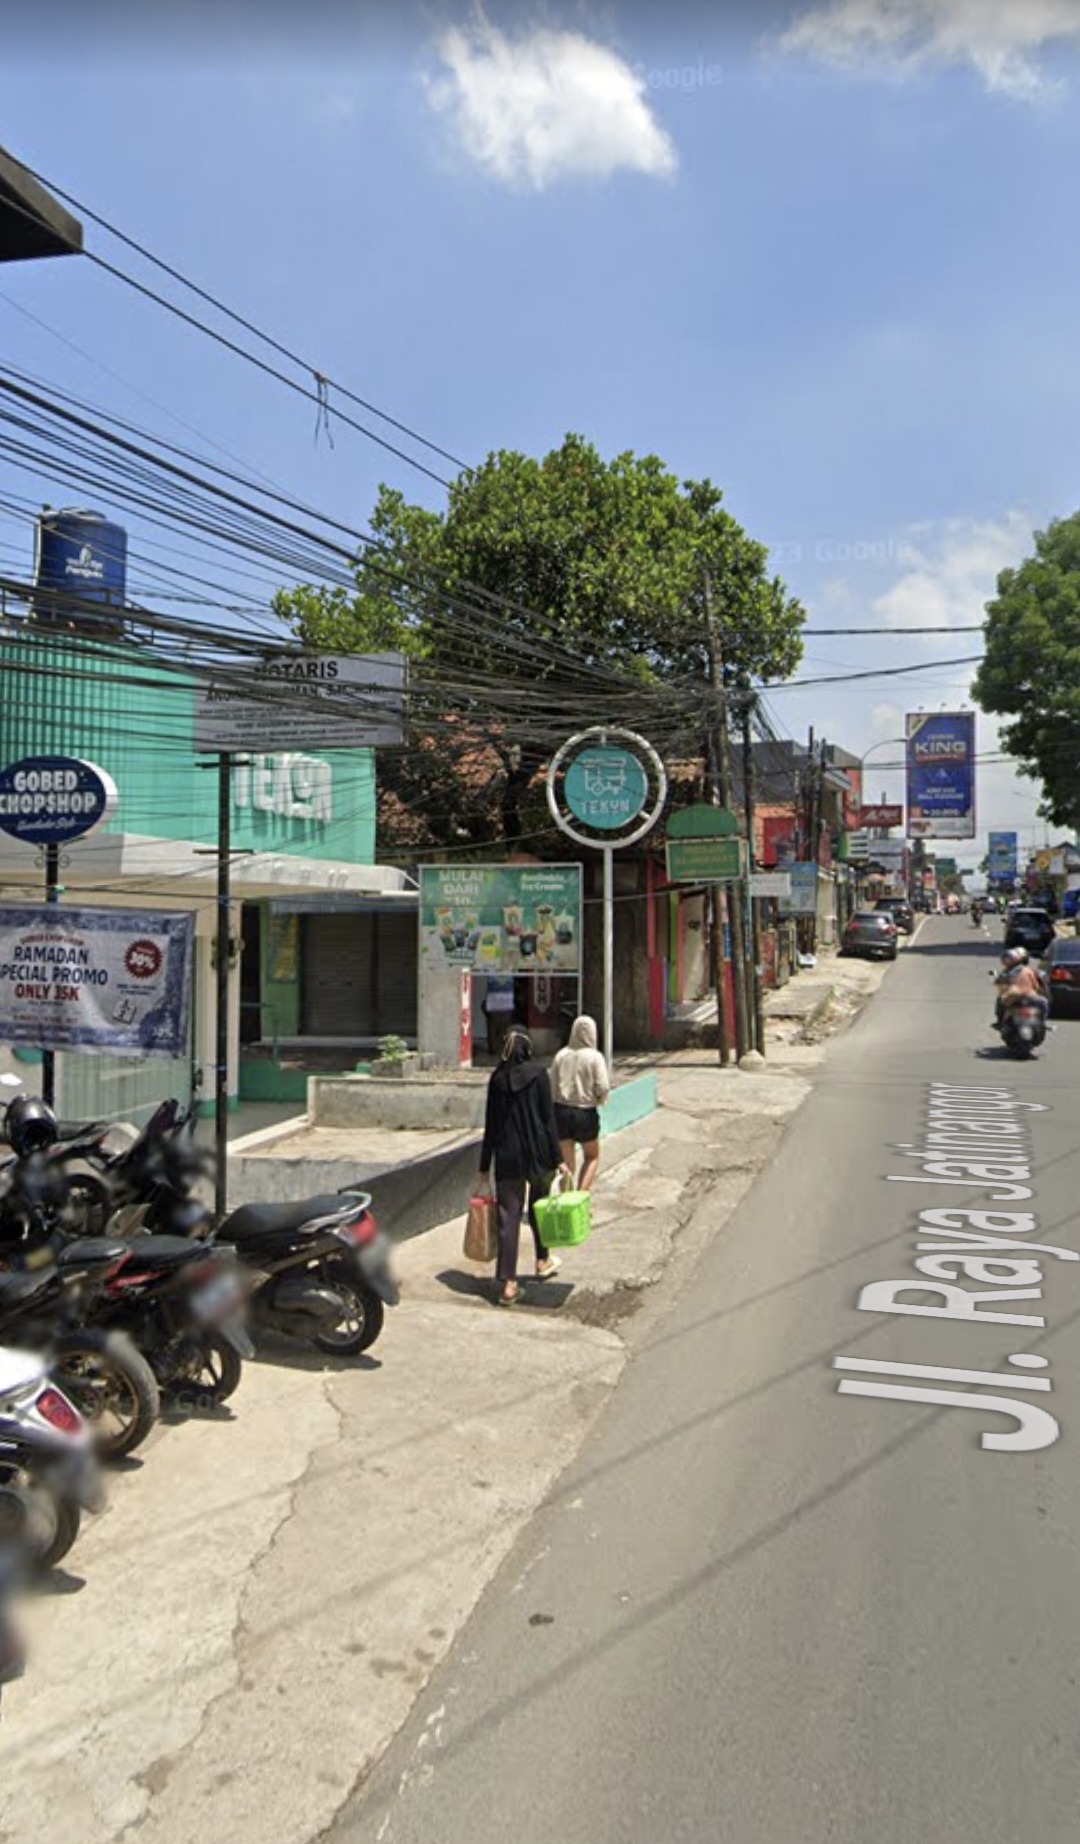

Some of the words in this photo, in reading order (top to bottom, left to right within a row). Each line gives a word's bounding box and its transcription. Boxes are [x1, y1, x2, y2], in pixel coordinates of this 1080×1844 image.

[915, 741, 967, 754] KING
[14, 769, 78, 792] GOBED
[581, 800, 630, 814] TEKUN
[14, 946, 90, 965] RAMADAN
[0, 964, 48, 982] PECIAL
[52, 966, 109, 986] PROMO
[14, 983, 51, 1000] ONLY
